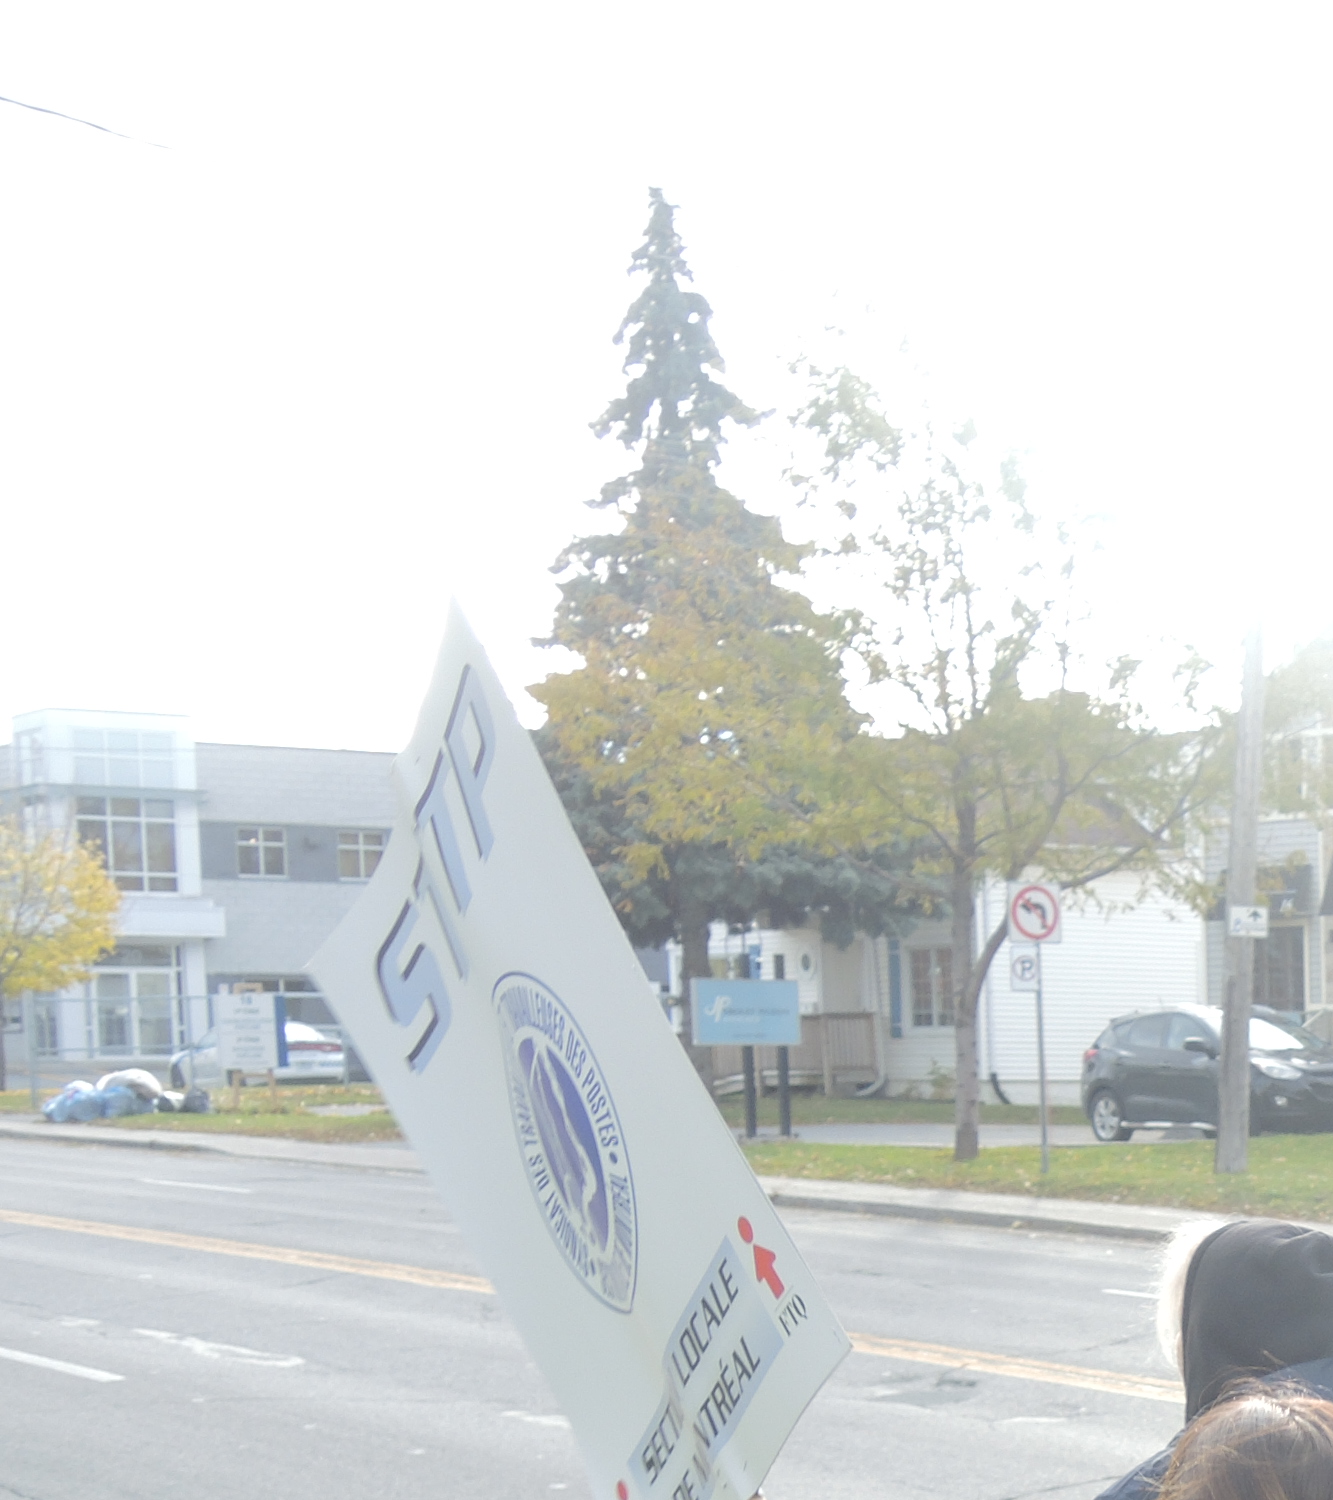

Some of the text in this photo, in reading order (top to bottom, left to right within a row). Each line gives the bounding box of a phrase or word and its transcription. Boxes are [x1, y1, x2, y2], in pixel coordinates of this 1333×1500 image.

[374, 662, 498, 1076] STTP
[566, 1028, 587, 1080] DES
[582, 1066, 619, 1149] POSTES
[641, 1257, 739, 1486] SECT LOCALE
[777, 1293, 808, 1338] FTQ
[692, 1335, 761, 1490] NTRÉAL
